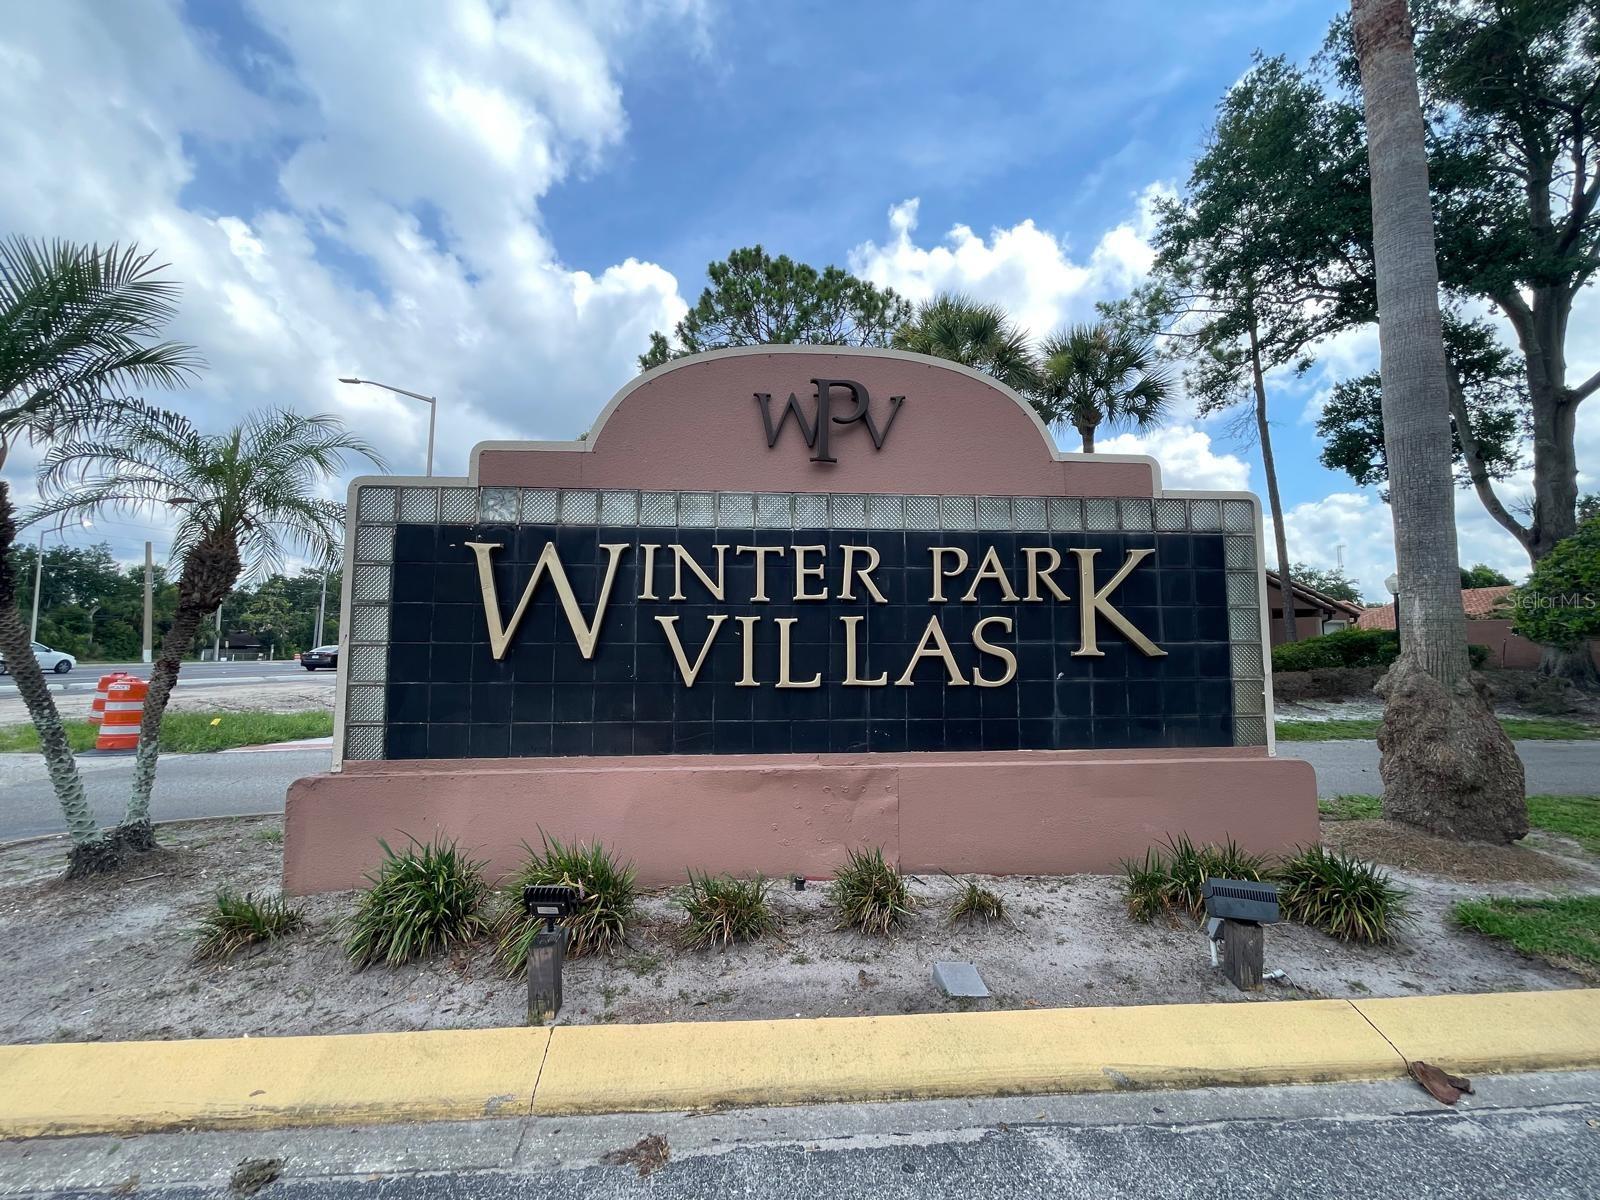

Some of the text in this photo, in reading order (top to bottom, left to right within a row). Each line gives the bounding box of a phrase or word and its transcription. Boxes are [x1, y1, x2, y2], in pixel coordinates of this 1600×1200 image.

[753, 379, 906, 464] WPV
[464, 542, 1169, 660] WINTER PARK
[654, 614, 1019, 688] VILLAS
